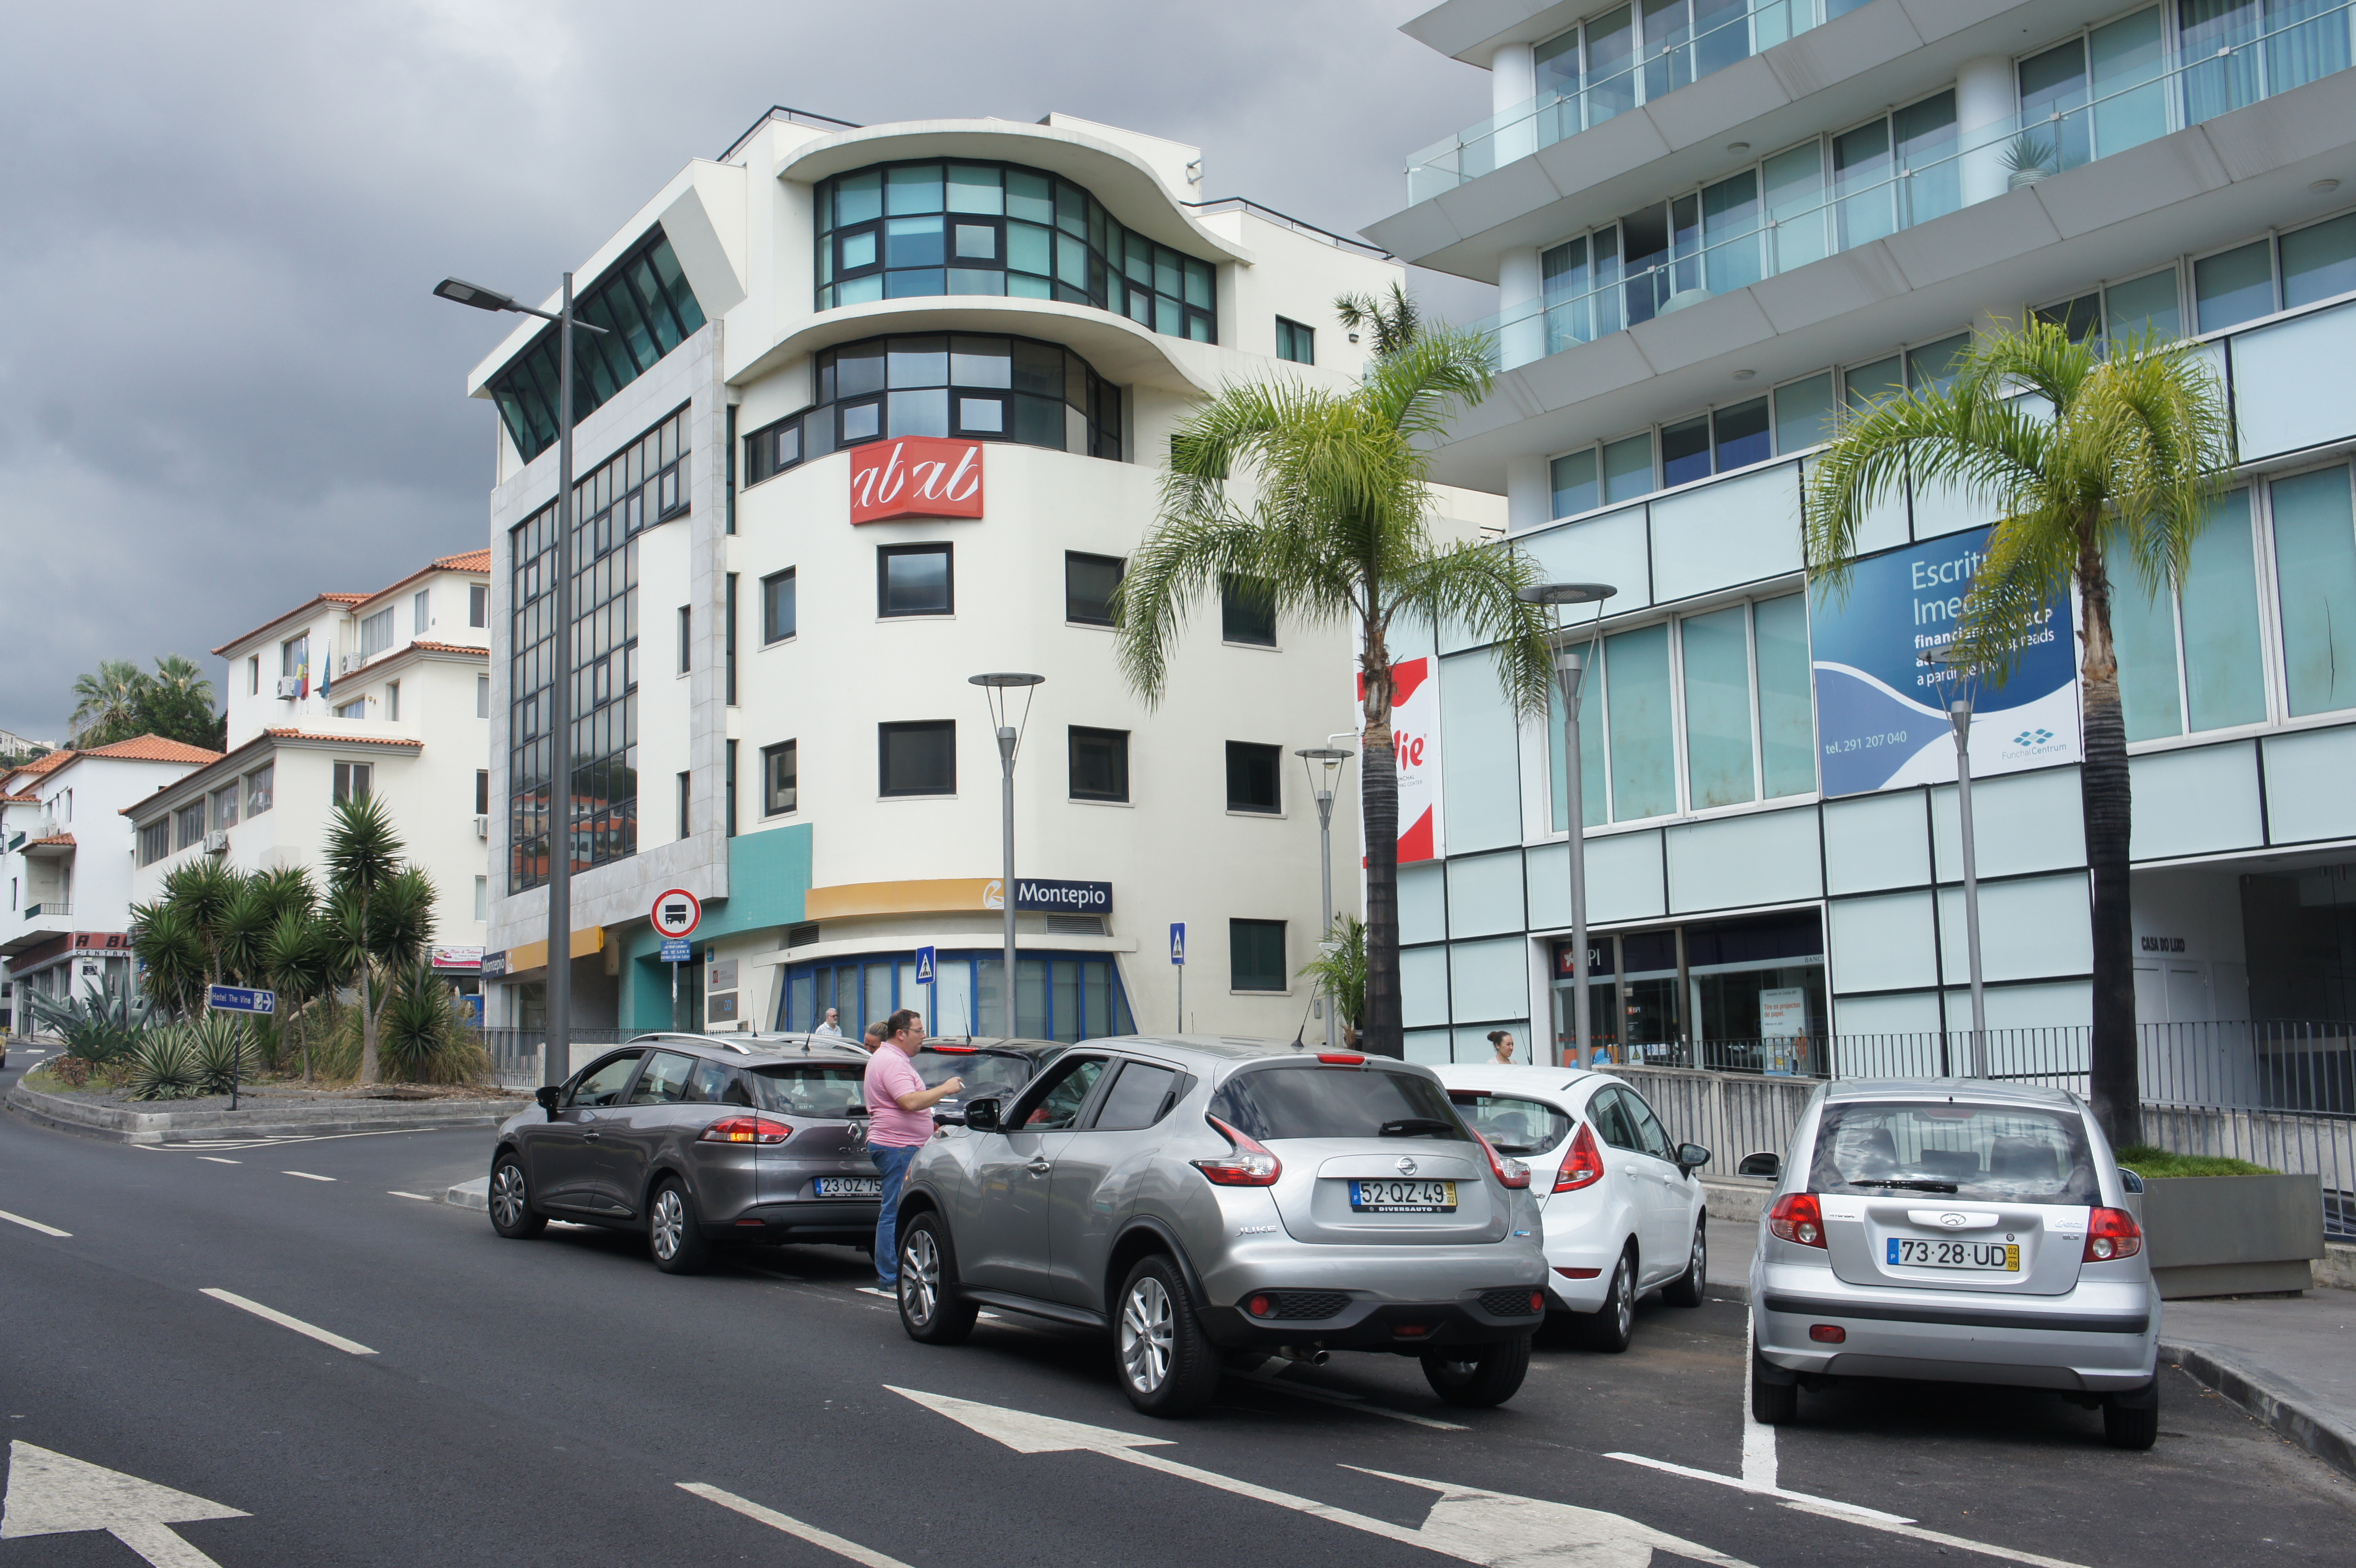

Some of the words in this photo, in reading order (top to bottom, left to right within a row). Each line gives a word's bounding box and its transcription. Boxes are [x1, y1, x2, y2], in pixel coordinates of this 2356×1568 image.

[1825, 741, 1842, 755] tel.
[1844, 738, 1861, 752] 291
[1866, 734, 1884, 748] 207
[1888, 731, 1907, 744] 040
[1018, 883, 1106, 909] Montepio
[2141, 936, 2159, 951] CASA
[2159, 937, 2169, 952] DO
[2170, 937, 2185, 953] LIXO
[481, 954, 505, 974] Montepio
[1588, 948, 1601, 966] PI
[212, 993, 226, 1002] Hotel
[229, 994, 238, 1003] The
[240, 995, 251, 1004] Vine
[1779, 1002, 1801, 1010] projectos
[1235, 1225, 1277, 1237] JUKE
